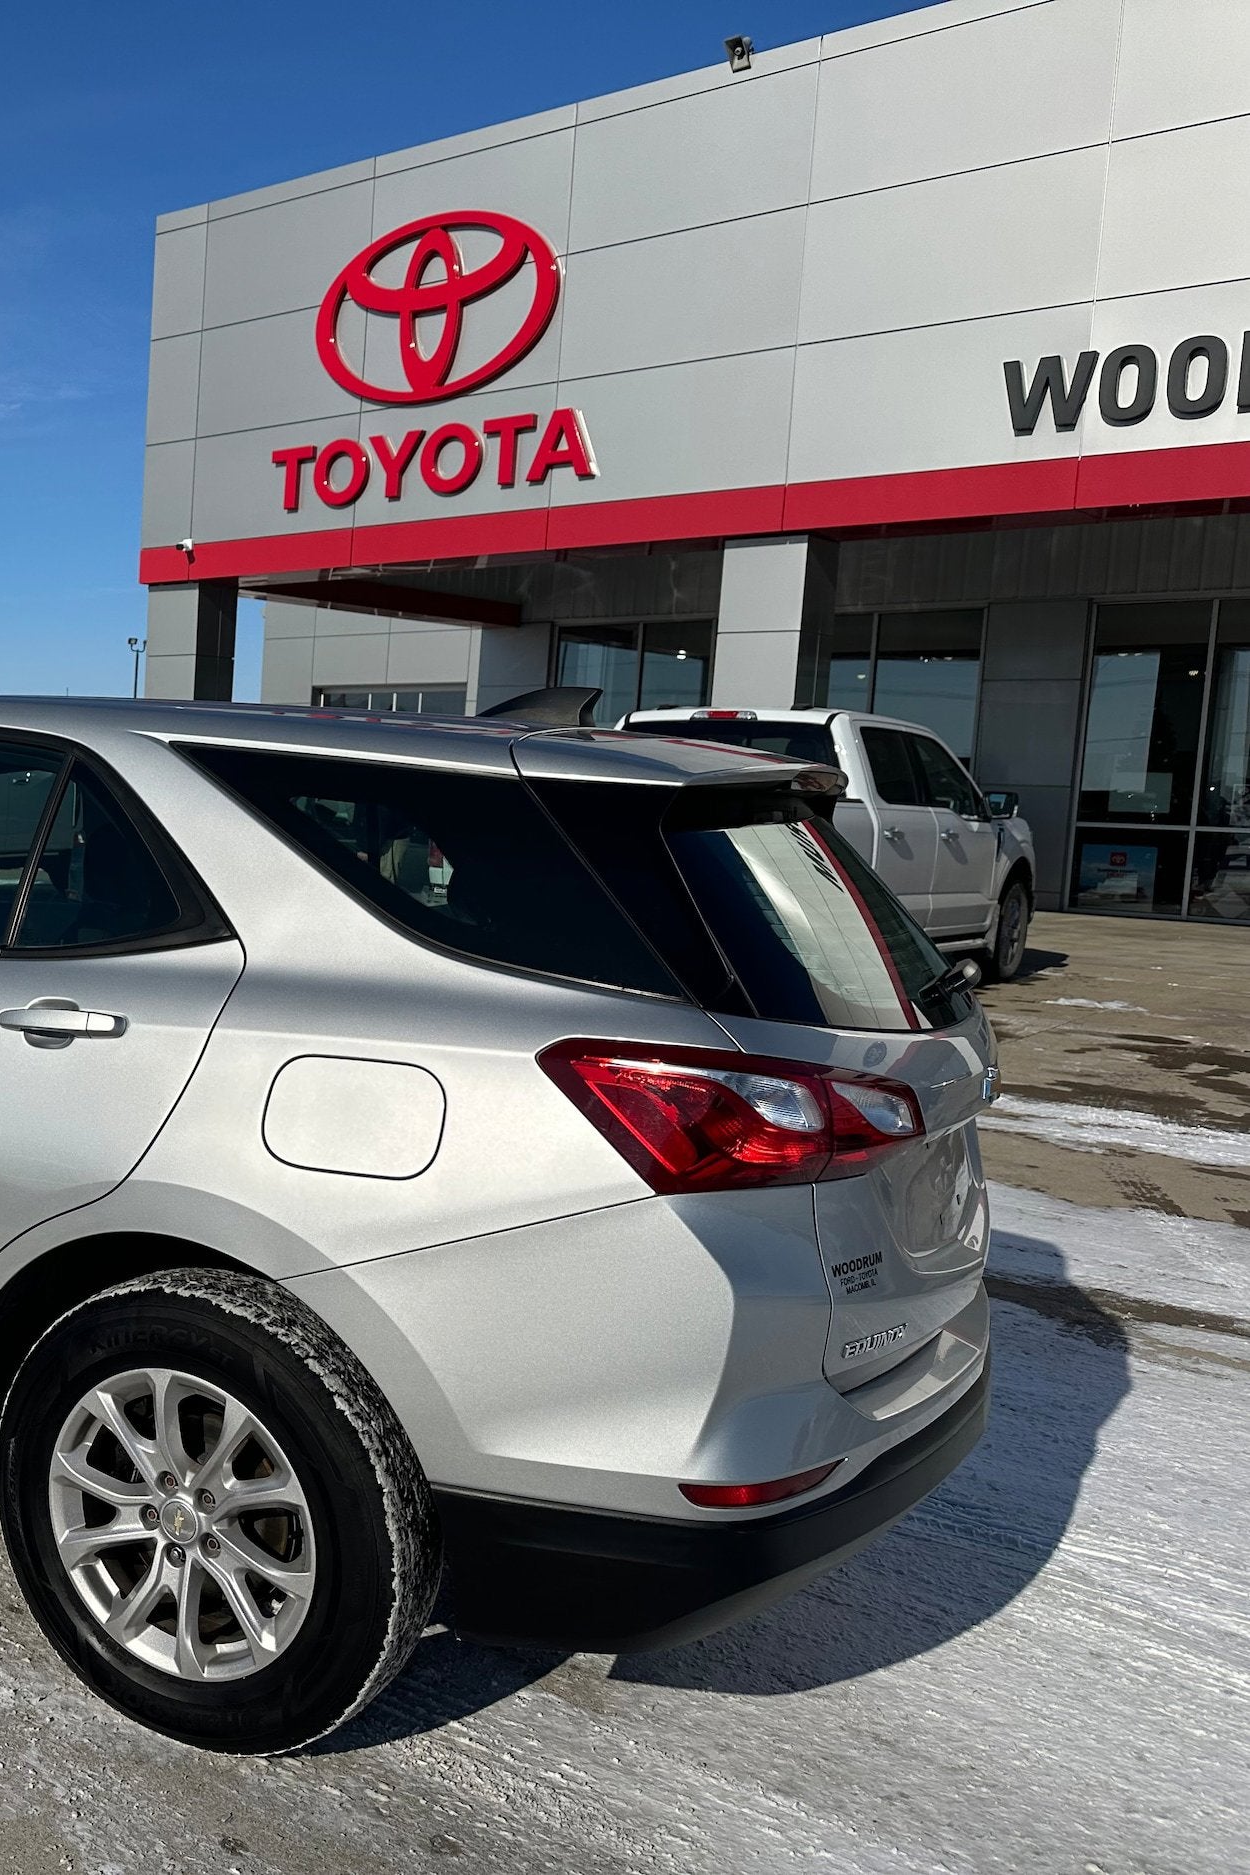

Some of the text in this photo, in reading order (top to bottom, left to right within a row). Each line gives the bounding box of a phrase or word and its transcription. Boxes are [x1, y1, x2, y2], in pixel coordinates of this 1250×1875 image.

[271, 408, 600, 513] TOYOTA
[832, 1251, 883, 1278] WOODRUM
[841, 1323, 908, 1359] EQUINOX
